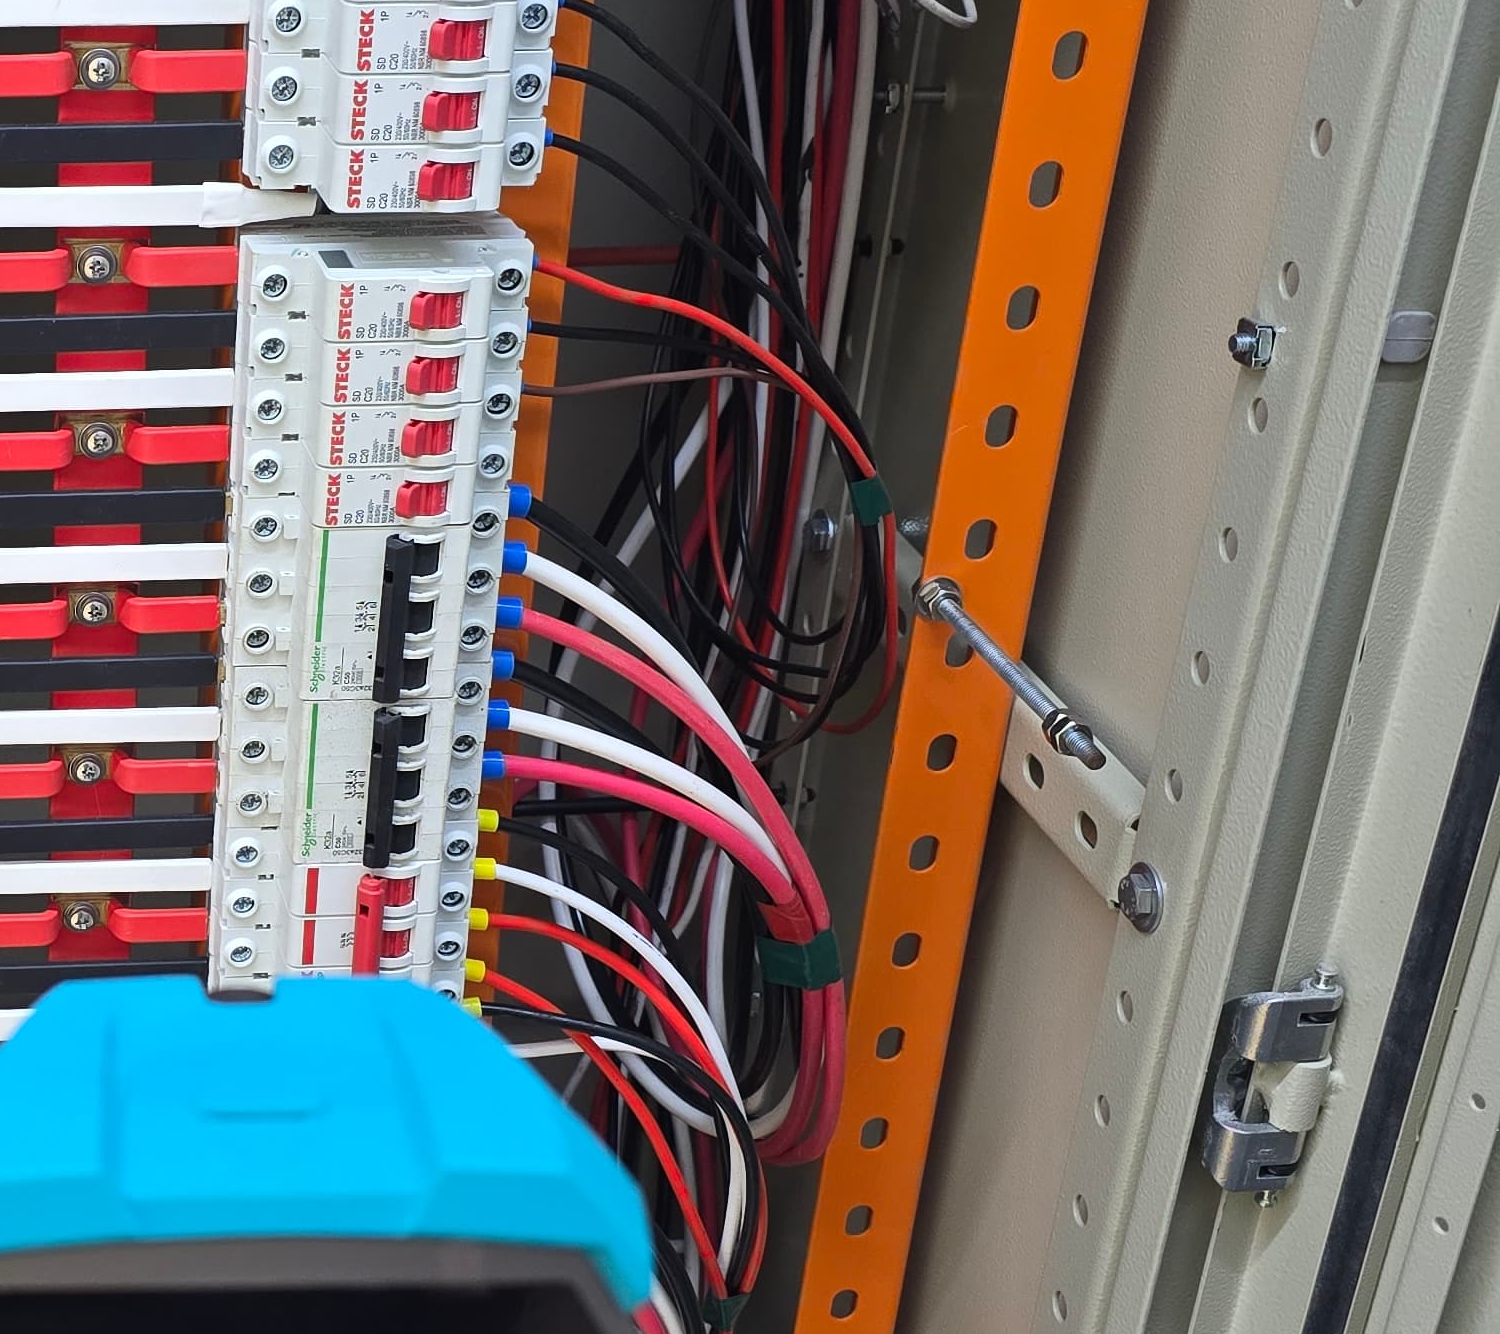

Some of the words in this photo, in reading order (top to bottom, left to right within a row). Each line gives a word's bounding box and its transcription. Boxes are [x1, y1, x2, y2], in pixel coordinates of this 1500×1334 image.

[356, 10, 374, 71] STECK
[350, 81, 368, 140] STECK
[347, 150, 364, 208] STECK
[338, 285, 354, 340] STECK
[334, 349, 351, 403] STECK
[329, 412, 346, 466] STECK
[325, 474, 341, 526] STECK
[309, 645, 325, 693] Schneider
[301, 812, 317, 857] Schneider
